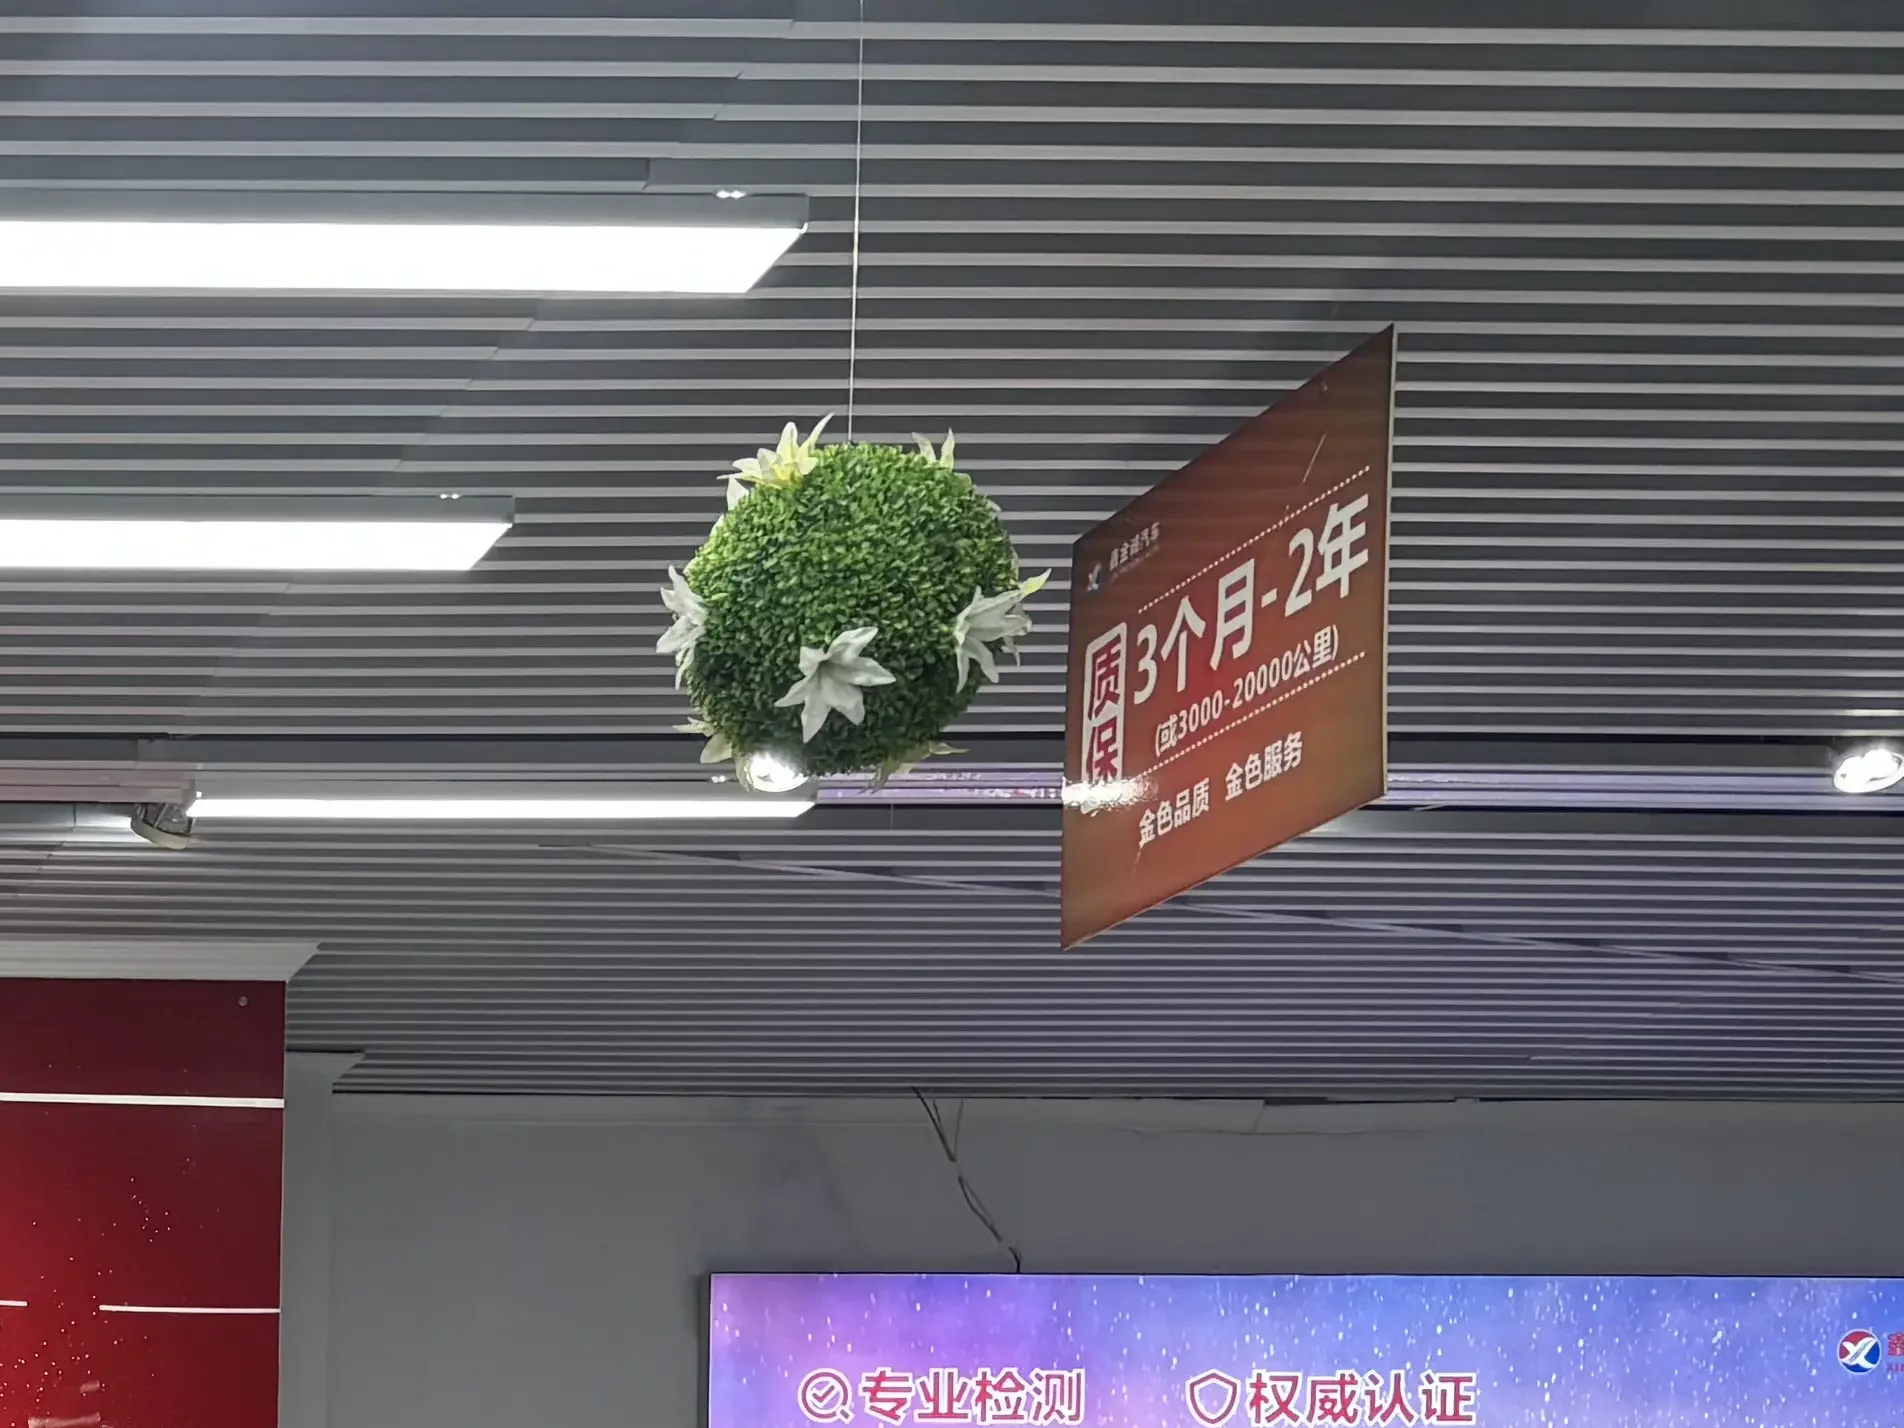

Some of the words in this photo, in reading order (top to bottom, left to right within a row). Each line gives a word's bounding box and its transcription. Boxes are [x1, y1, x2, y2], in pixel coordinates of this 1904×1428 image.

[1133, 493, 1370, 705] 3个月-2年
[1087, 632, 1122, 786] 质保
[1138, 776, 1211, 849] 金色品质
[1224, 731, 1303, 803] 金色服务
[858, 1368, 1085, 1428] 专业检测
[1245, 1370, 1477, 1428] 权威认证
